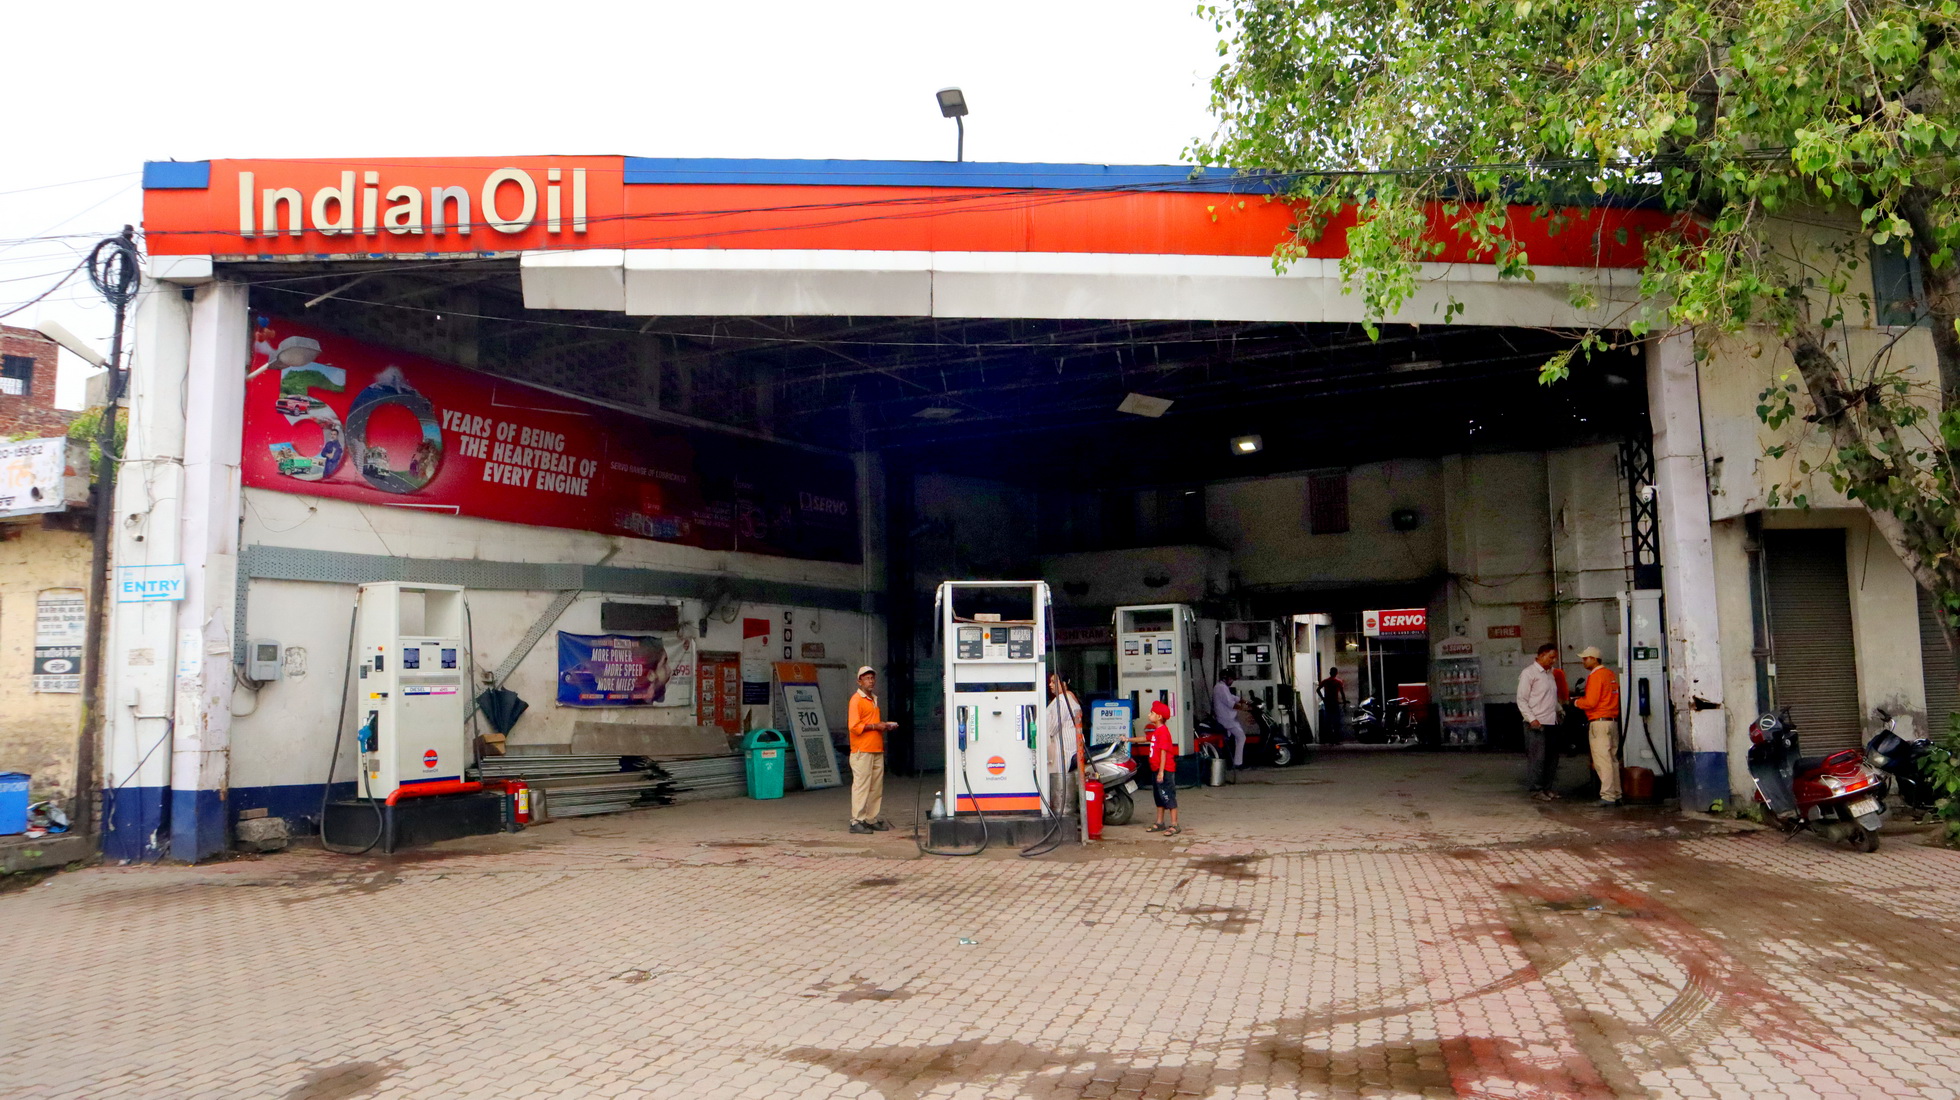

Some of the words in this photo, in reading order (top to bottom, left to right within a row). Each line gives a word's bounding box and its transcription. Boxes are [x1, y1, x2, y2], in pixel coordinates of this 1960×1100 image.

[238, 167, 587, 238] IndianOil
[441, 408, 493, 438] YEARS
[496, 421, 517, 442] OF
[519, 426, 566, 453] BEING
[459, 434, 490, 459] THE
[492, 441, 577, 475] HEARTBEAT
[579, 458, 598, 479] OF
[482, 461, 534, 488] EVERY
[535, 470, 590, 497] ENGINE
[609, 461, 629, 473] SERVO
[629, 465, 647, 476] RANGE
[648, 469, 655, 477] OF
[655, 469, 688, 484] LUBRICANTS
[812, 495, 848, 516] SERVO
[123, 579, 181, 593] ENTRY
[1382, 614, 1424, 627] SERVO
[1495, 628, 1515, 636] FIRE
[591, 648, 610, 662] MORE
[610, 649, 633, 663] POWER
[603, 662, 623, 677] MORE
[623, 663, 643, 678] SPEED
[596, 677, 615, 692] MORE
[616, 679, 635, 692] MILES
